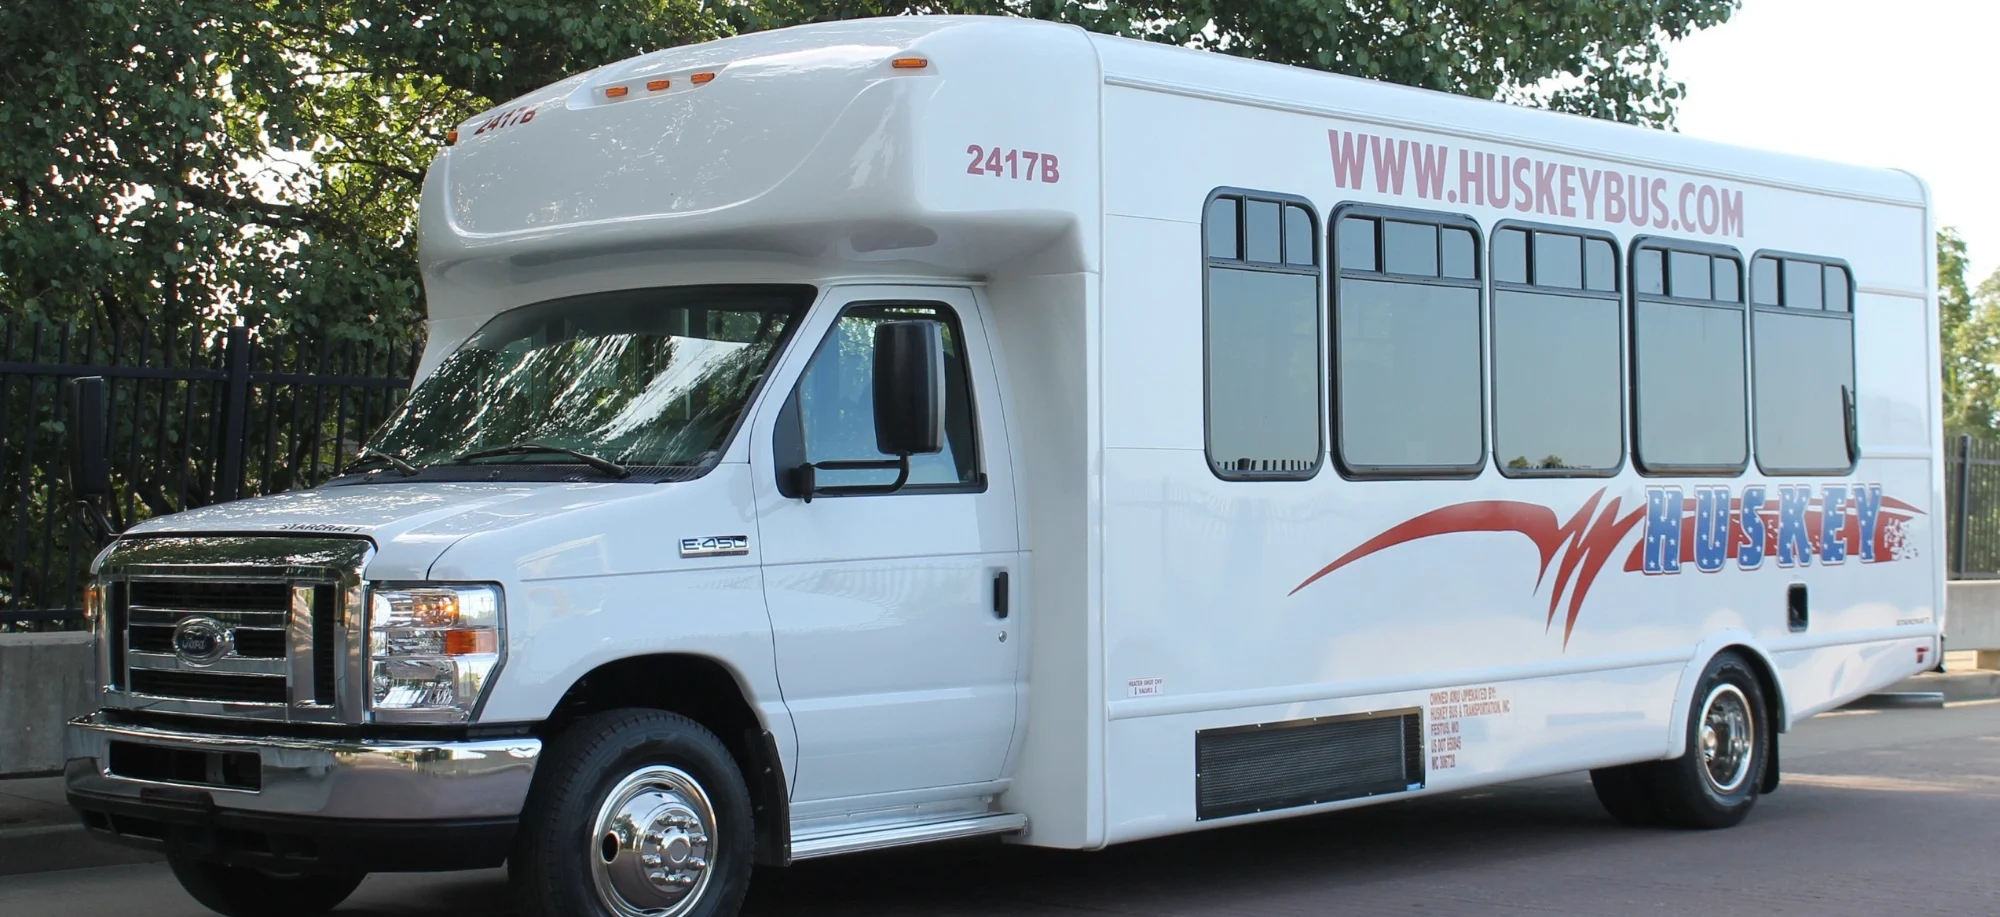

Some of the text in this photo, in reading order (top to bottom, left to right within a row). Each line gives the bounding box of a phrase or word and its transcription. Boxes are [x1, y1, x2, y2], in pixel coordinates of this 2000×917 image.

[967, 144, 1060, 184] 2417B
[1328, 129, 1744, 238] WWW.HUSKEYBUS.COM
[280, 523, 364, 533] STARCRAFT
[1643, 483, 1882, 574] HUSKEY
[1430, 691, 1448, 705] OWNED
[1461, 687, 1487, 703] OPERATED
[1430, 706, 1448, 720] HUSKEY
[1449, 704, 1458, 719] BUS
[1431, 738, 1438, 753] US
[1438, 737, 1446, 753] DOT
